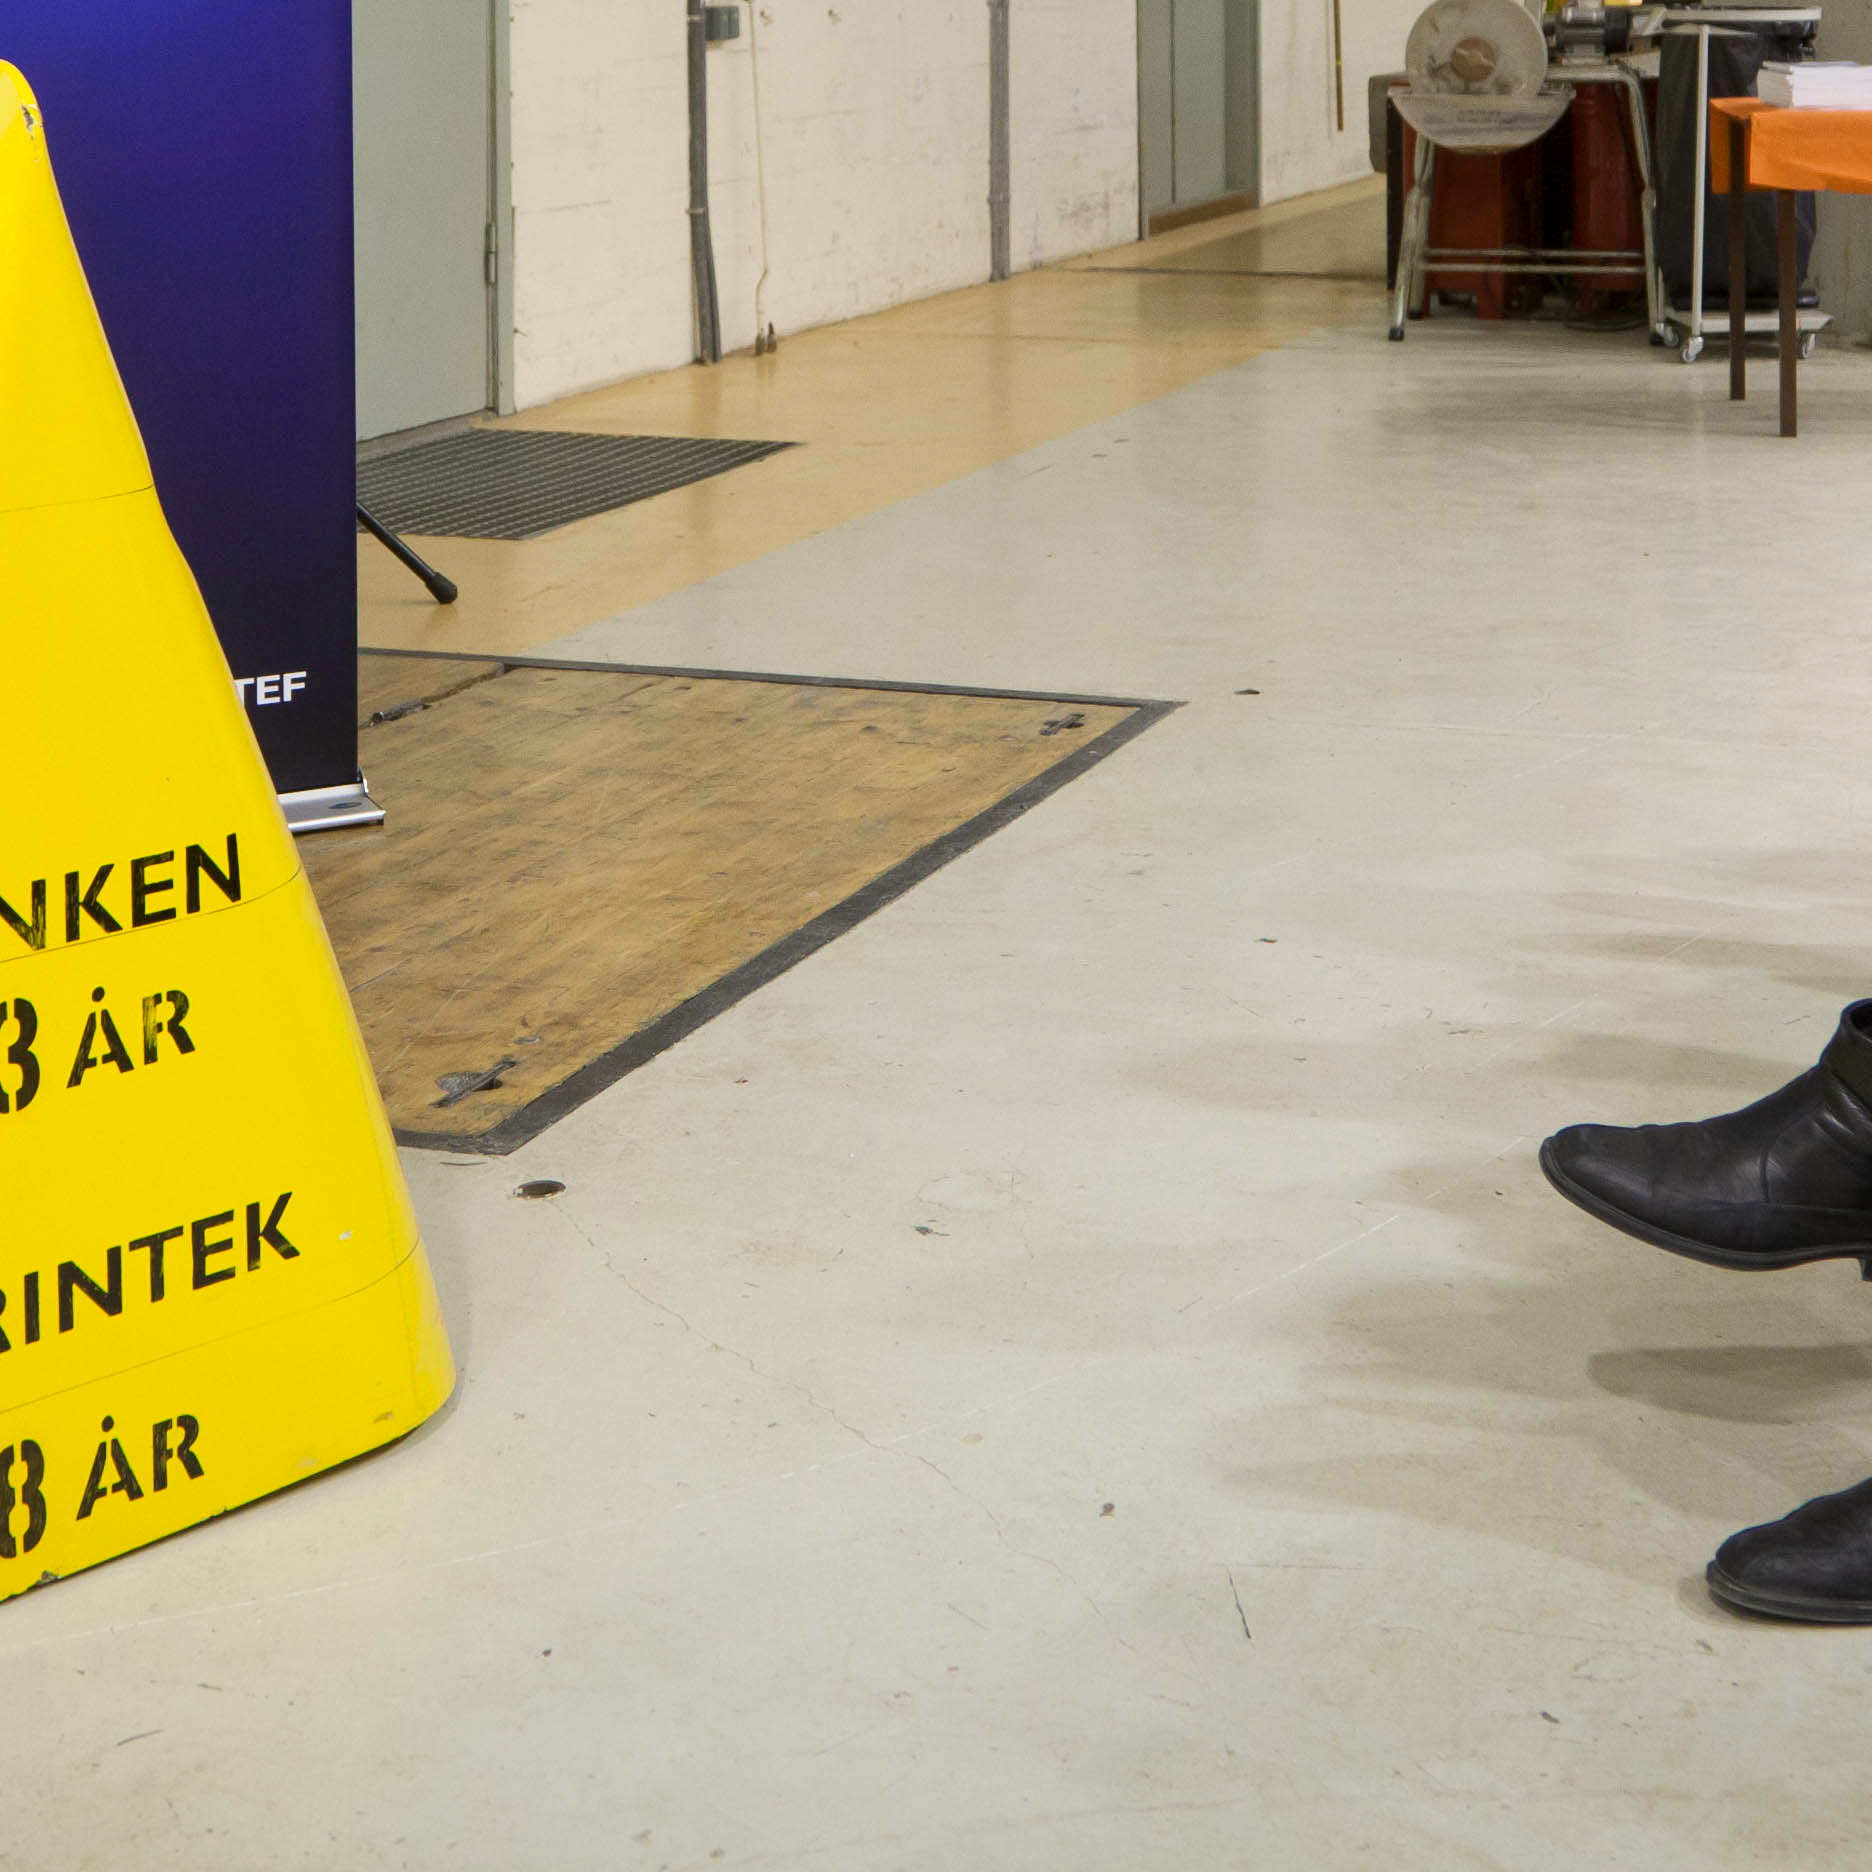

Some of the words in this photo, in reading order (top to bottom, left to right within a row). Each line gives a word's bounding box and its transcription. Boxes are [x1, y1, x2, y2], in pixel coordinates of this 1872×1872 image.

[233, 669, 308, 706] TEF
[66, 985, 196, 1089] ÅR
[76, 1413, 206, 1521] ÅR
